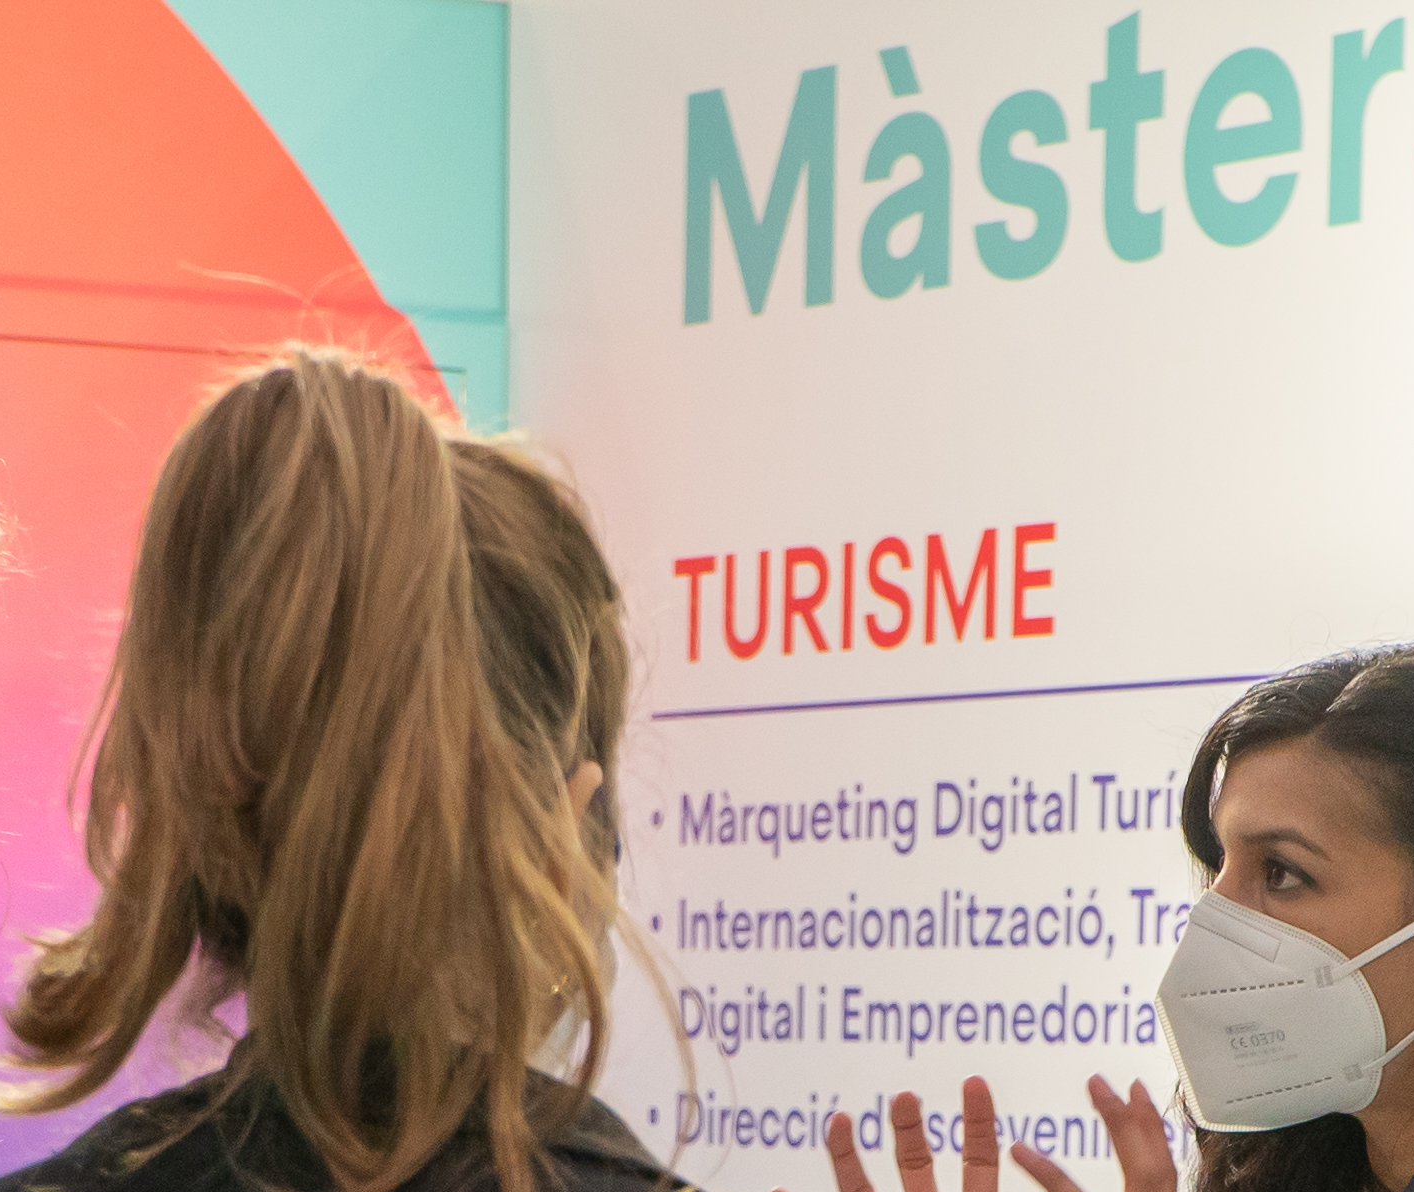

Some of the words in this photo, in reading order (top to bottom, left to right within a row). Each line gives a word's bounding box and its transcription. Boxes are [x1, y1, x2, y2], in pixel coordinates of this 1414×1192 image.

[674, 522, 1057, 662] TURISME
[679, 783, 918, 858] Màrqueting
[934, 773, 1077, 852] Digital
[1092, 769, 1185, 832] Turí
[679, 887, 1115, 960] Internacionalització,
[679, 984, 805, 1056] Digital
[818, 985, 827, 1041] i
[842, 984, 1156, 1058] Emprenedoria
